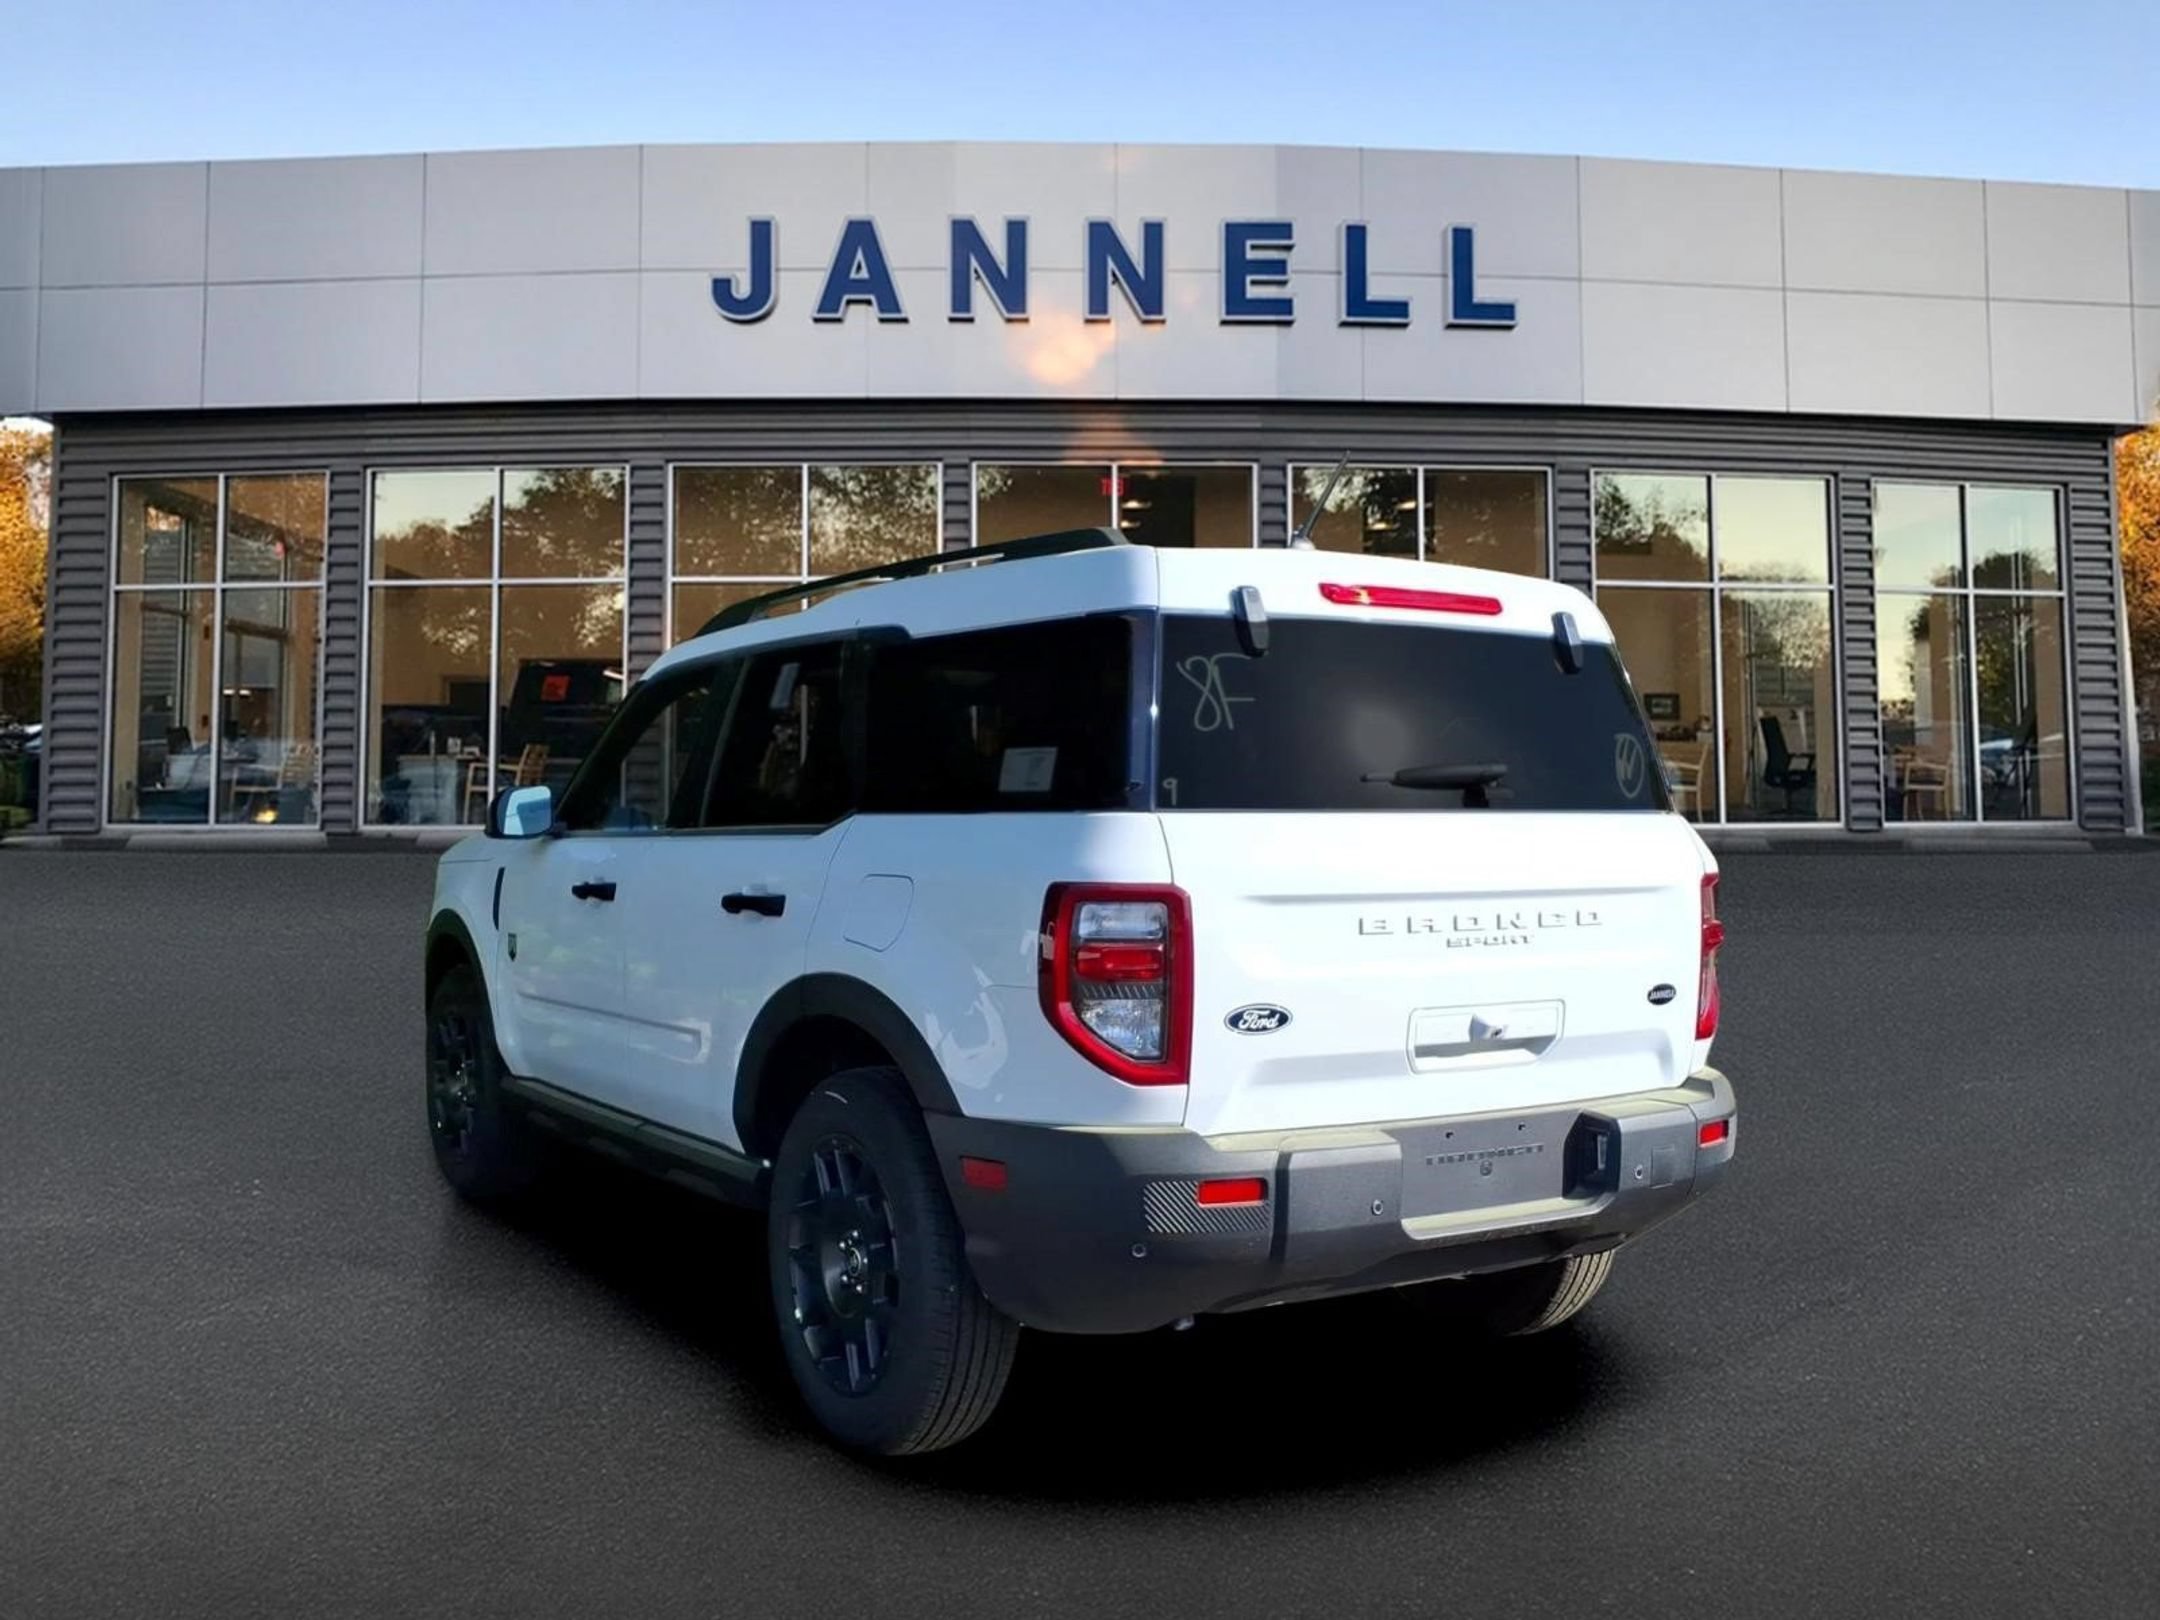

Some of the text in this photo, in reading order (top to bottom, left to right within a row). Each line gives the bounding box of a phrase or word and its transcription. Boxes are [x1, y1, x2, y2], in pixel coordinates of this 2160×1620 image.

[710, 215, 1517, 328] JANNELL
[1358, 909, 1603, 936] BRONCO
[1446, 934, 1532, 949] SPORT
[1237, 1009, 1281, 1029] Ford
